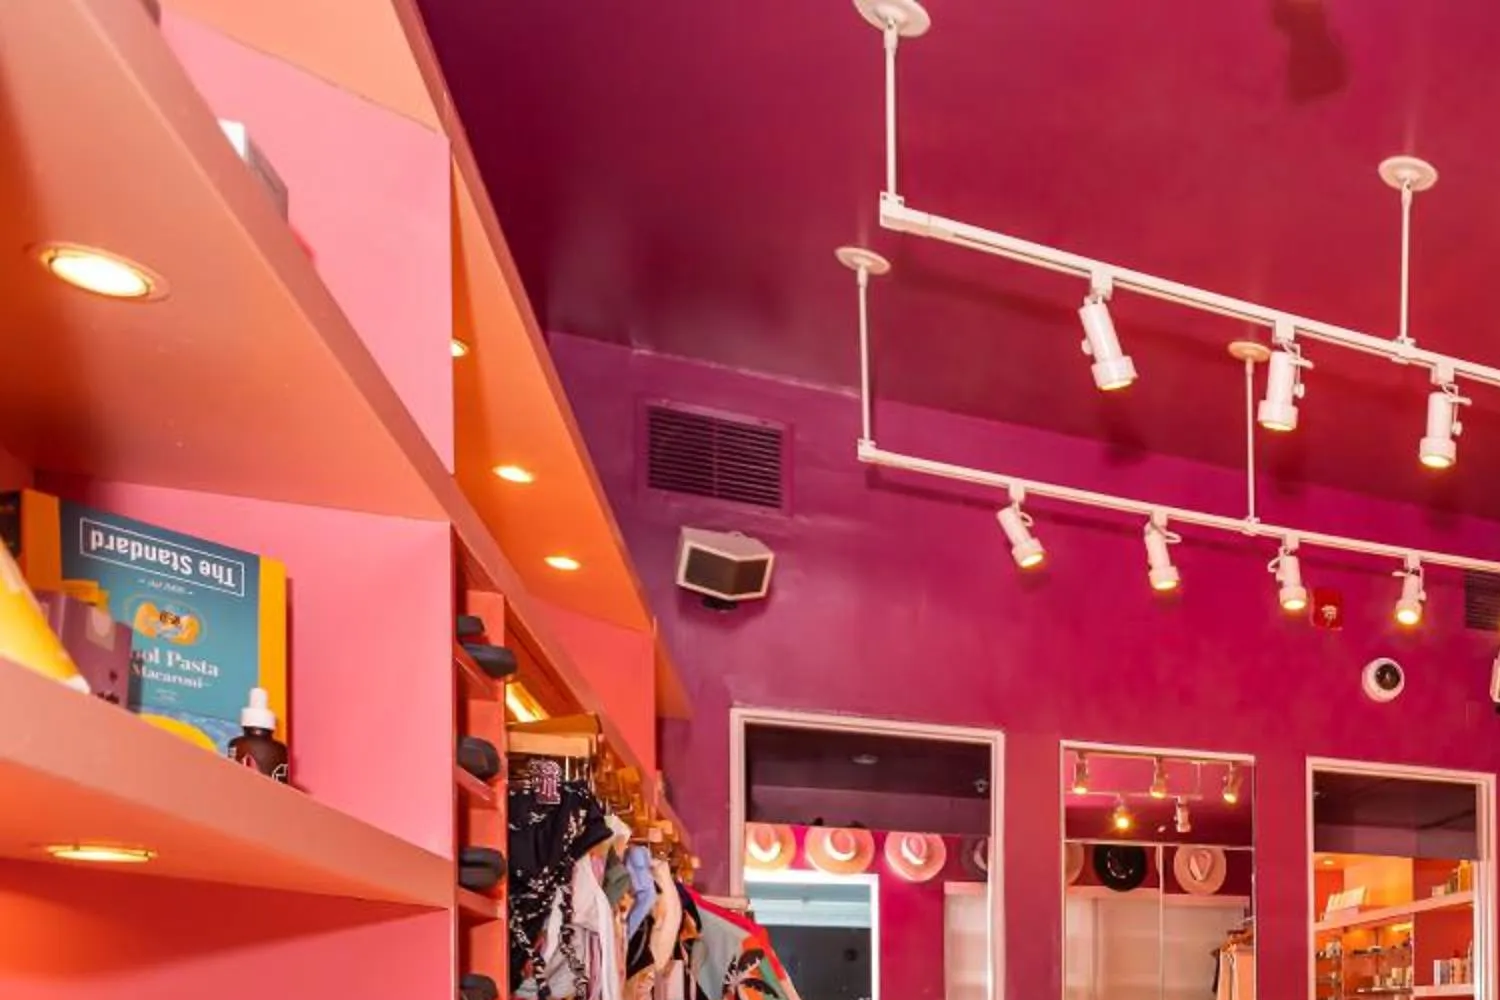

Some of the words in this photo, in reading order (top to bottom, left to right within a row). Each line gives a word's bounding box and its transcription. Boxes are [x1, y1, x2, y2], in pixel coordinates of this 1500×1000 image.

[89, 528, 193, 576] Standard
[199, 560, 237, 588] The
[166, 650, 220, 679] Pasta
